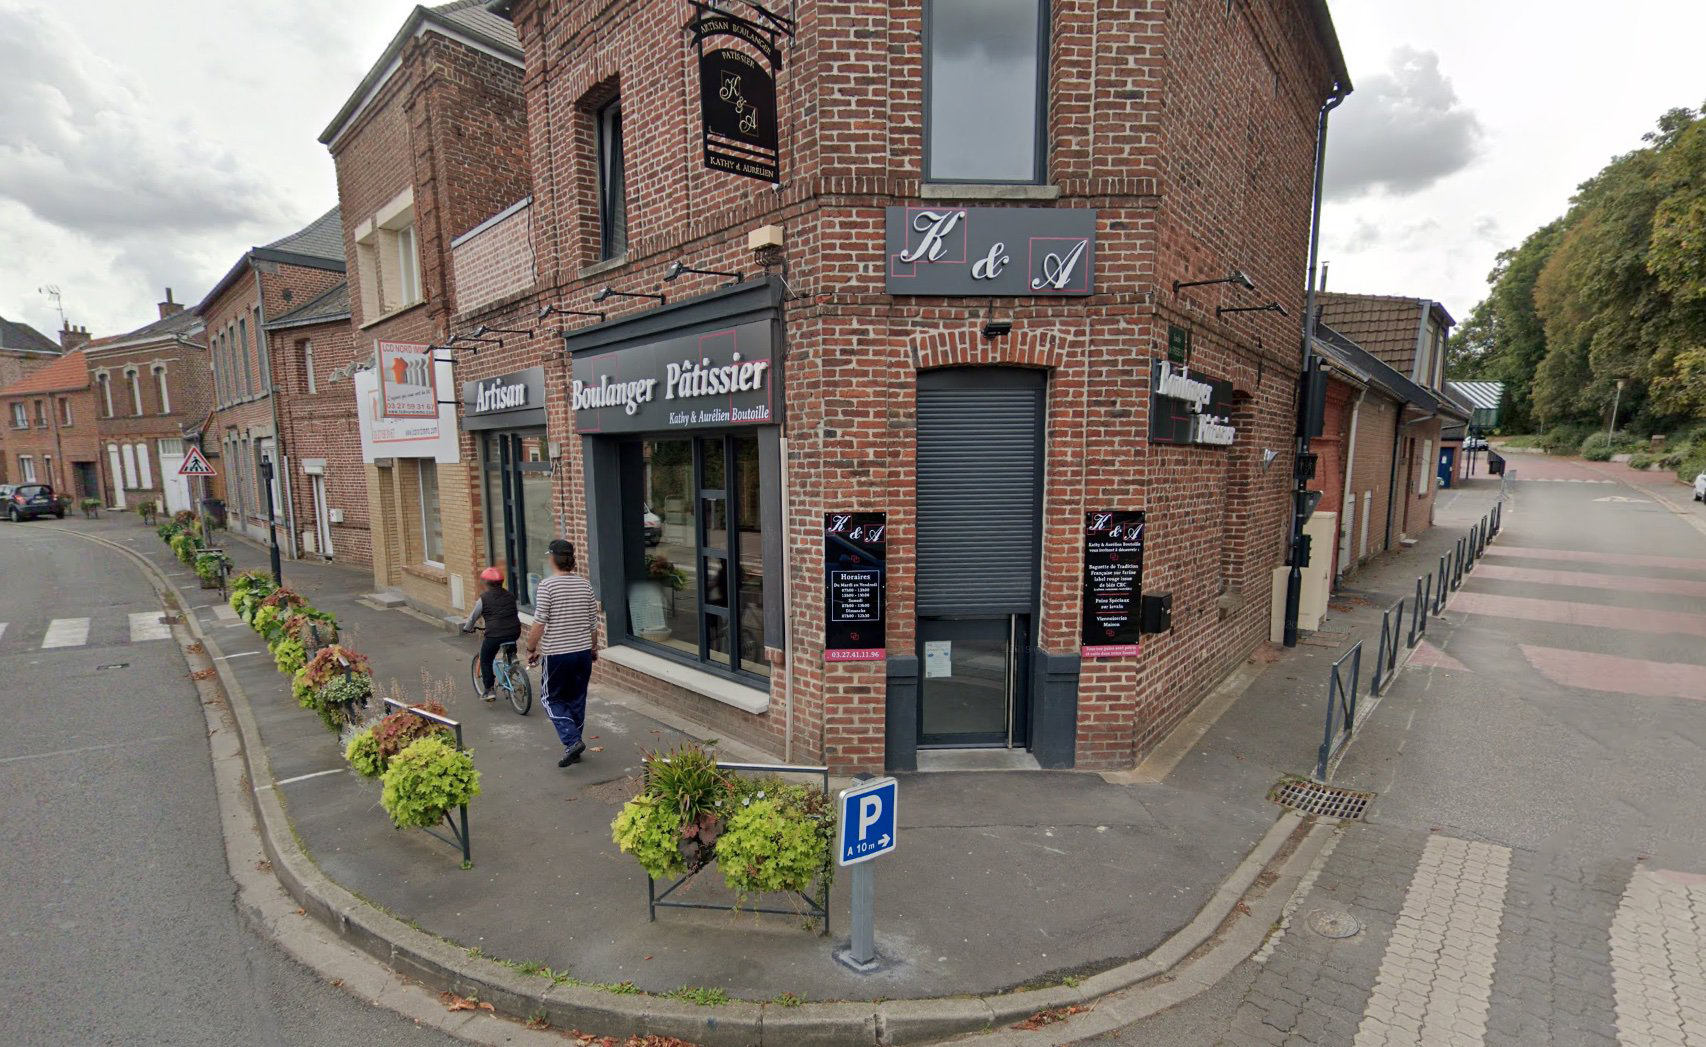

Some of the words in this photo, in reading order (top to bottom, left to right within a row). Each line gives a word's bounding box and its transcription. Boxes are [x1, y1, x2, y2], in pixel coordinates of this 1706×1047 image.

[700, 21, 729, 34] ARTISAN
[732, 24, 771, 55] BOULANGER
[719, 75, 741, 100] K
[735, 96, 747, 114] &
[739, 107, 757, 133] A
[710, 157, 734, 170] KATHY
[743, 163, 774, 178] AURÉLIEN
[900, 210, 965, 262] K
[971, 242, 1009, 279] &
[1031, 239, 1088, 289] A
[382, 343, 395, 352] LCD
[395, 344, 412, 353] NORD
[476, 378, 526, 412] Artisan
[572, 375, 657, 415] Boulanger
[665, 352, 768, 399] Pâtissier
[669, 411, 689, 427] Kathy
[691, 413, 697, 423] &
[698, 408, 730, 424] Aurélien
[732, 405, 769, 421] Boutoille
[828, 515, 851, 532] K
[850, 526, 863, 540] &
[865, 525, 885, 542] A
[1089, 514, 1111, 530] K
[1109, 525, 1122, 538] &
[1124, 523, 1144, 540] A
[831, 651, 880, 659] 03.27.41.11.96
[859, 794, 882, 841] P
[847, 846, 853, 856] A
[856, 842, 867, 853] 10
